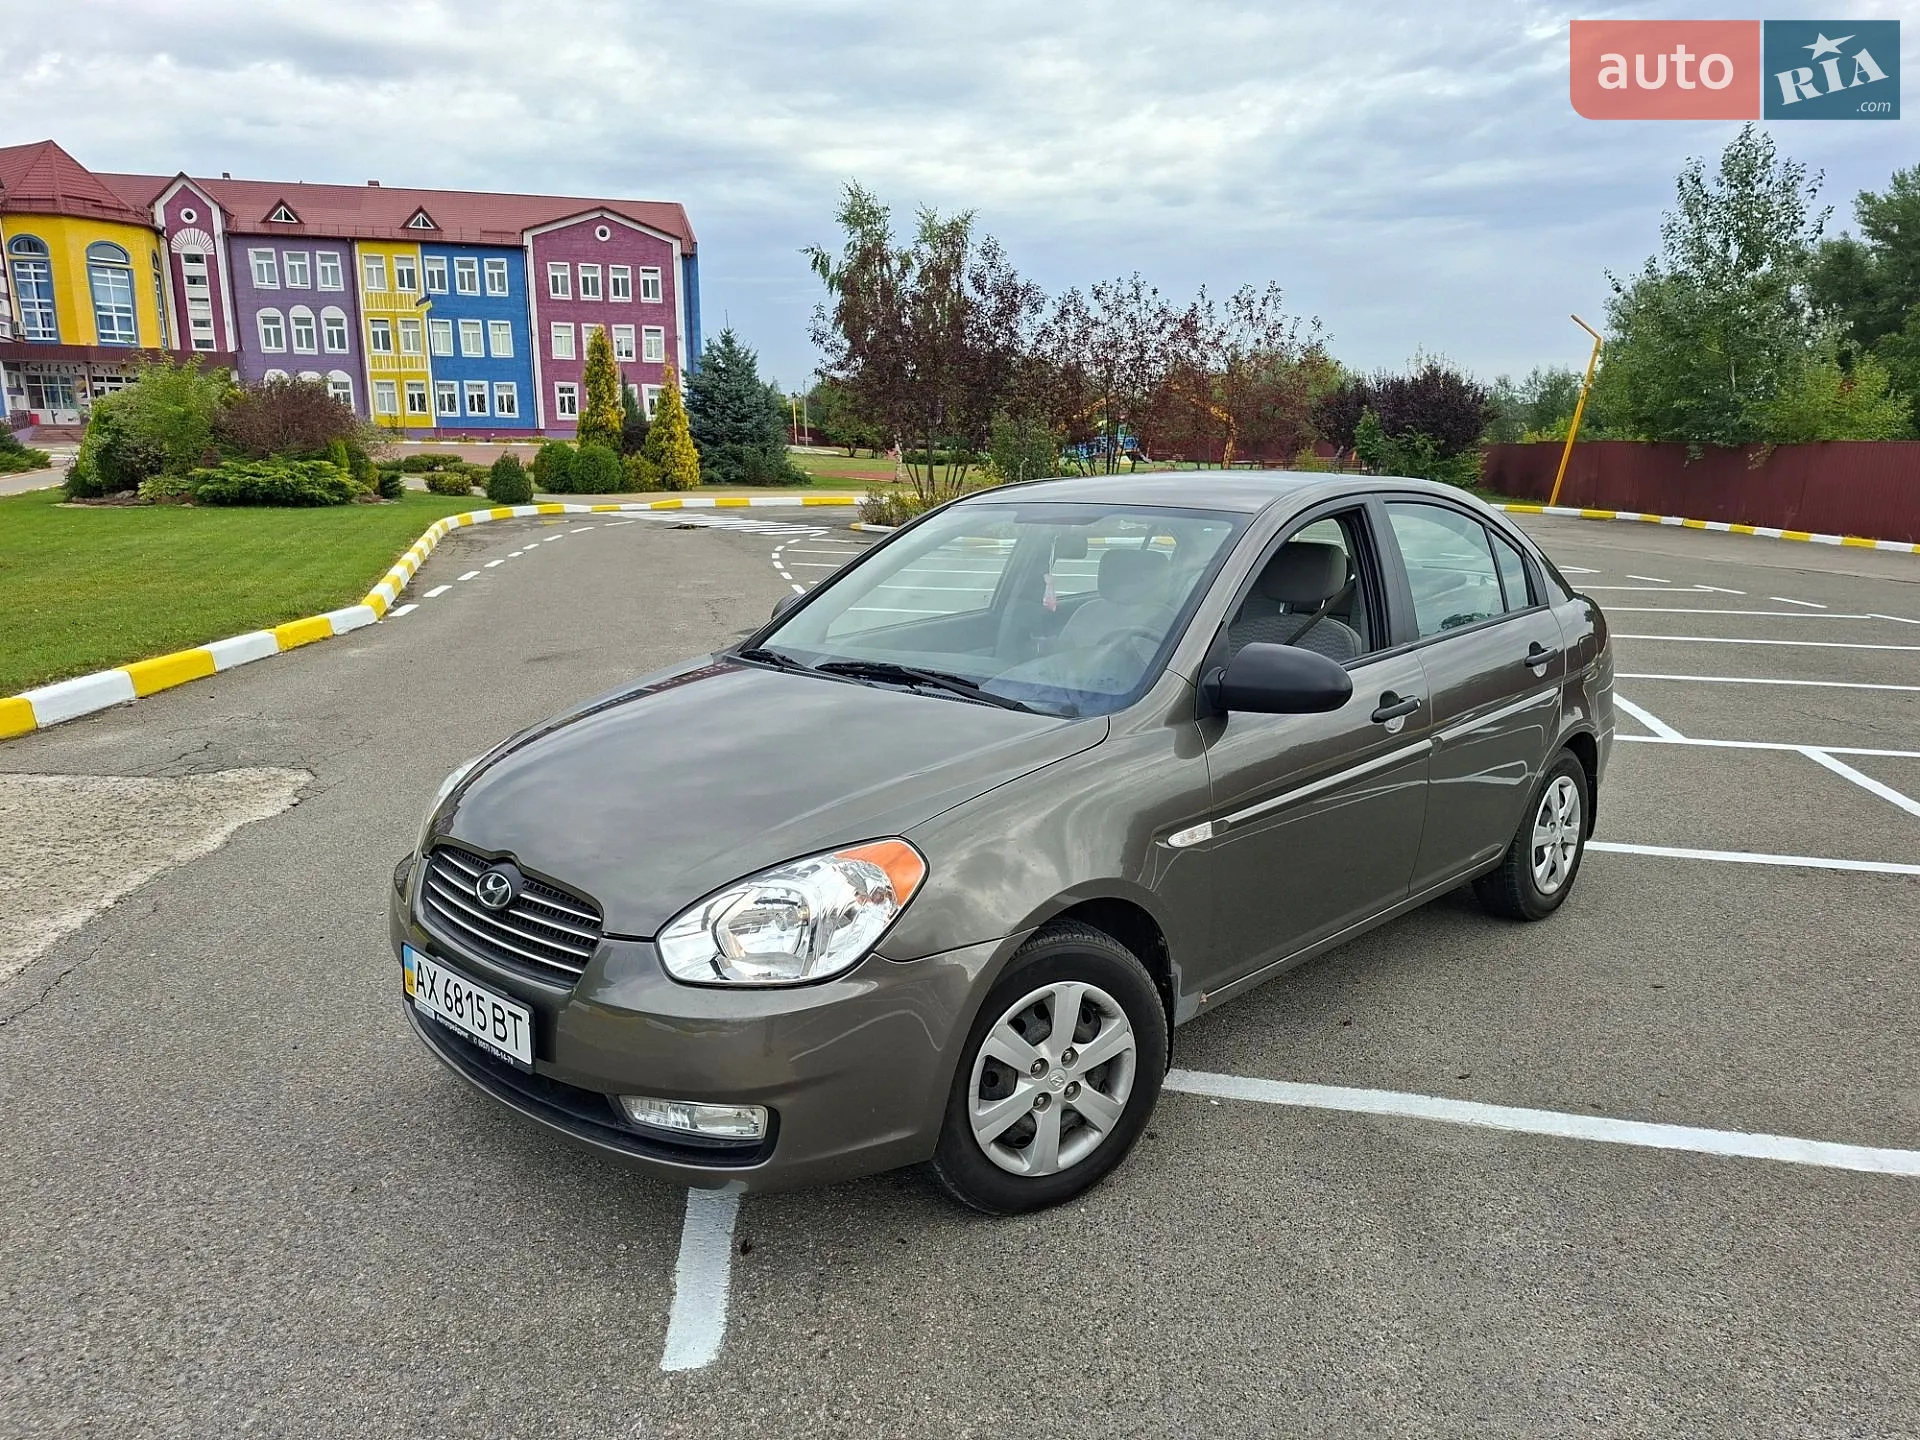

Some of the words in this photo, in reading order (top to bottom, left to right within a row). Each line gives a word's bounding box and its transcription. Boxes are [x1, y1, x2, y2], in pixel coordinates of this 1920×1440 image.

[416, 960, 439, 1005] AX
[444, 978, 487, 1031] 6815
[491, 1002, 523, 1050] BT
